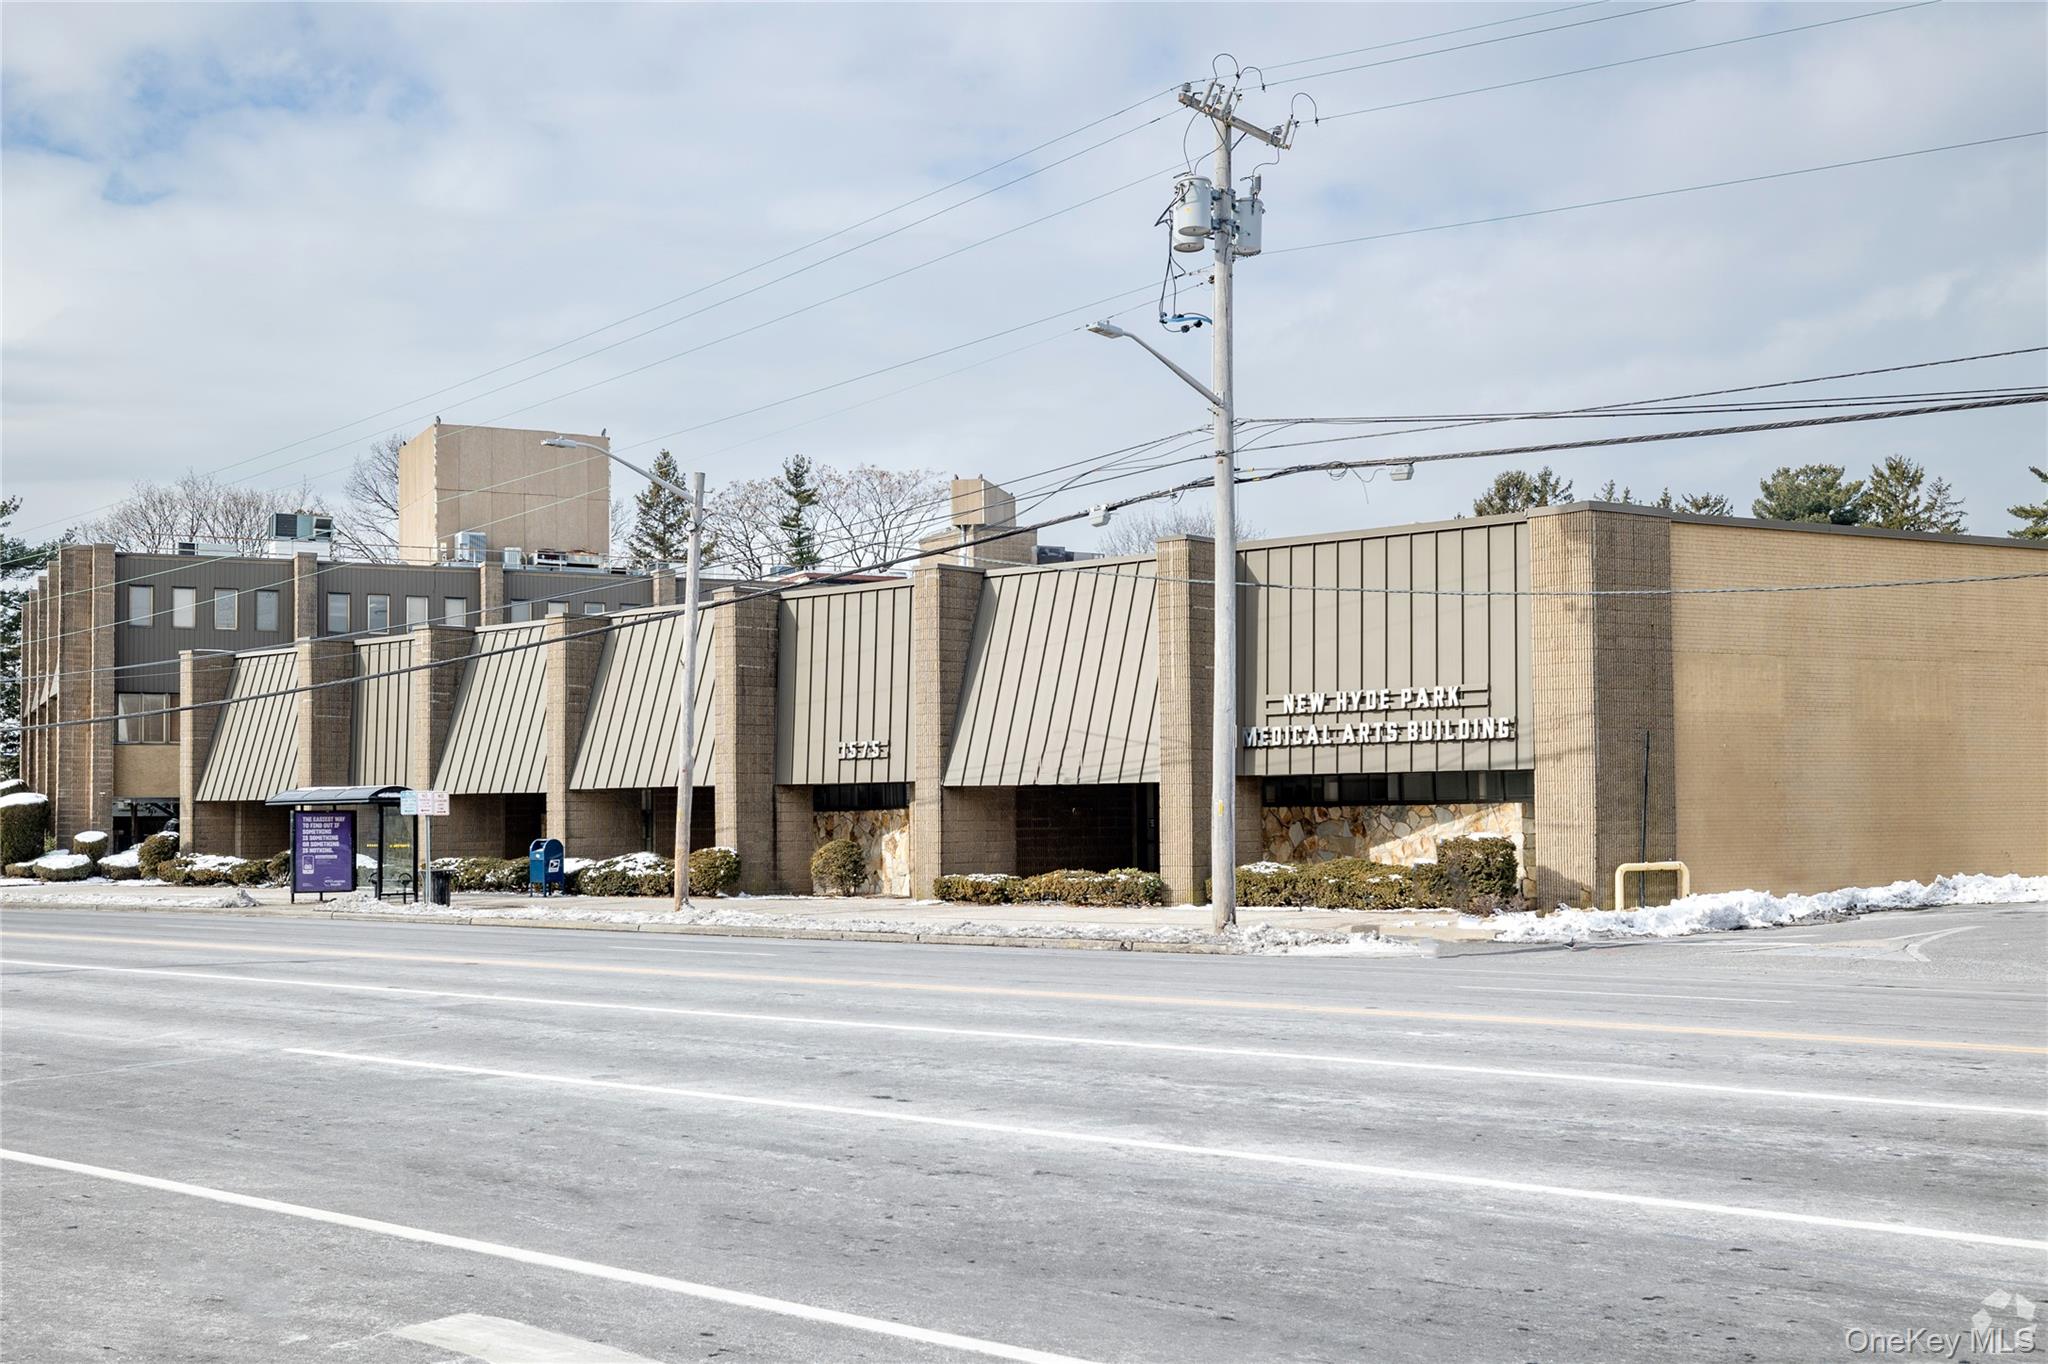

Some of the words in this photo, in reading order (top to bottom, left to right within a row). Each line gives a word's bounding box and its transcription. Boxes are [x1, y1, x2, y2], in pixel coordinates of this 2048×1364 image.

[1282, 692, 1326, 714] NEW
[1335, 688, 1391, 712] HYDE
[1400, 685, 1461, 710] PARK
[1242, 724, 1332, 747] MEDICAL
[1342, 720, 1400, 744] ARTS
[1407, 716, 1511, 742] BUILDING
[839, 740, 880, 759] 1575
